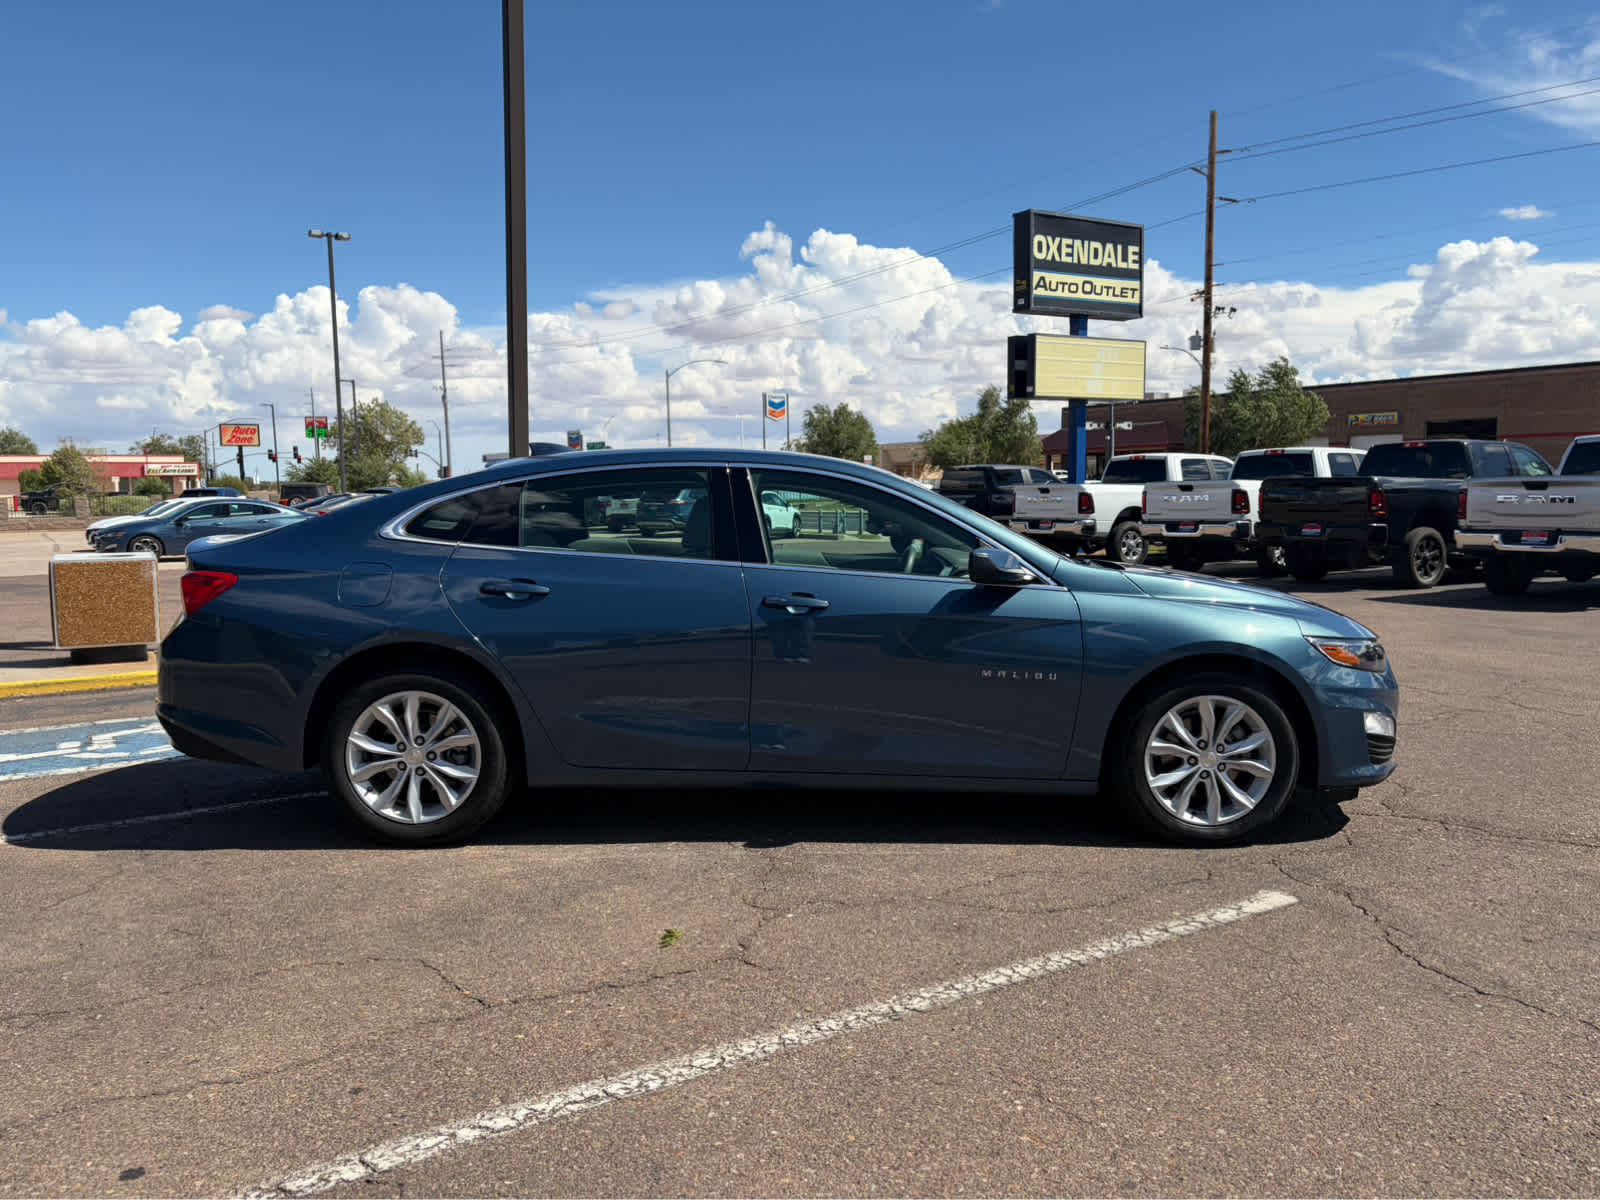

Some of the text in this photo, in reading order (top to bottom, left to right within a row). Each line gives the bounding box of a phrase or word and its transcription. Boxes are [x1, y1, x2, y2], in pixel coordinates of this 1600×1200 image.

[1033, 234, 1140, 270] OXENDALE
[1496, 495, 1577, 504] RAM
[981, 669, 1057, 681] MALIBU
